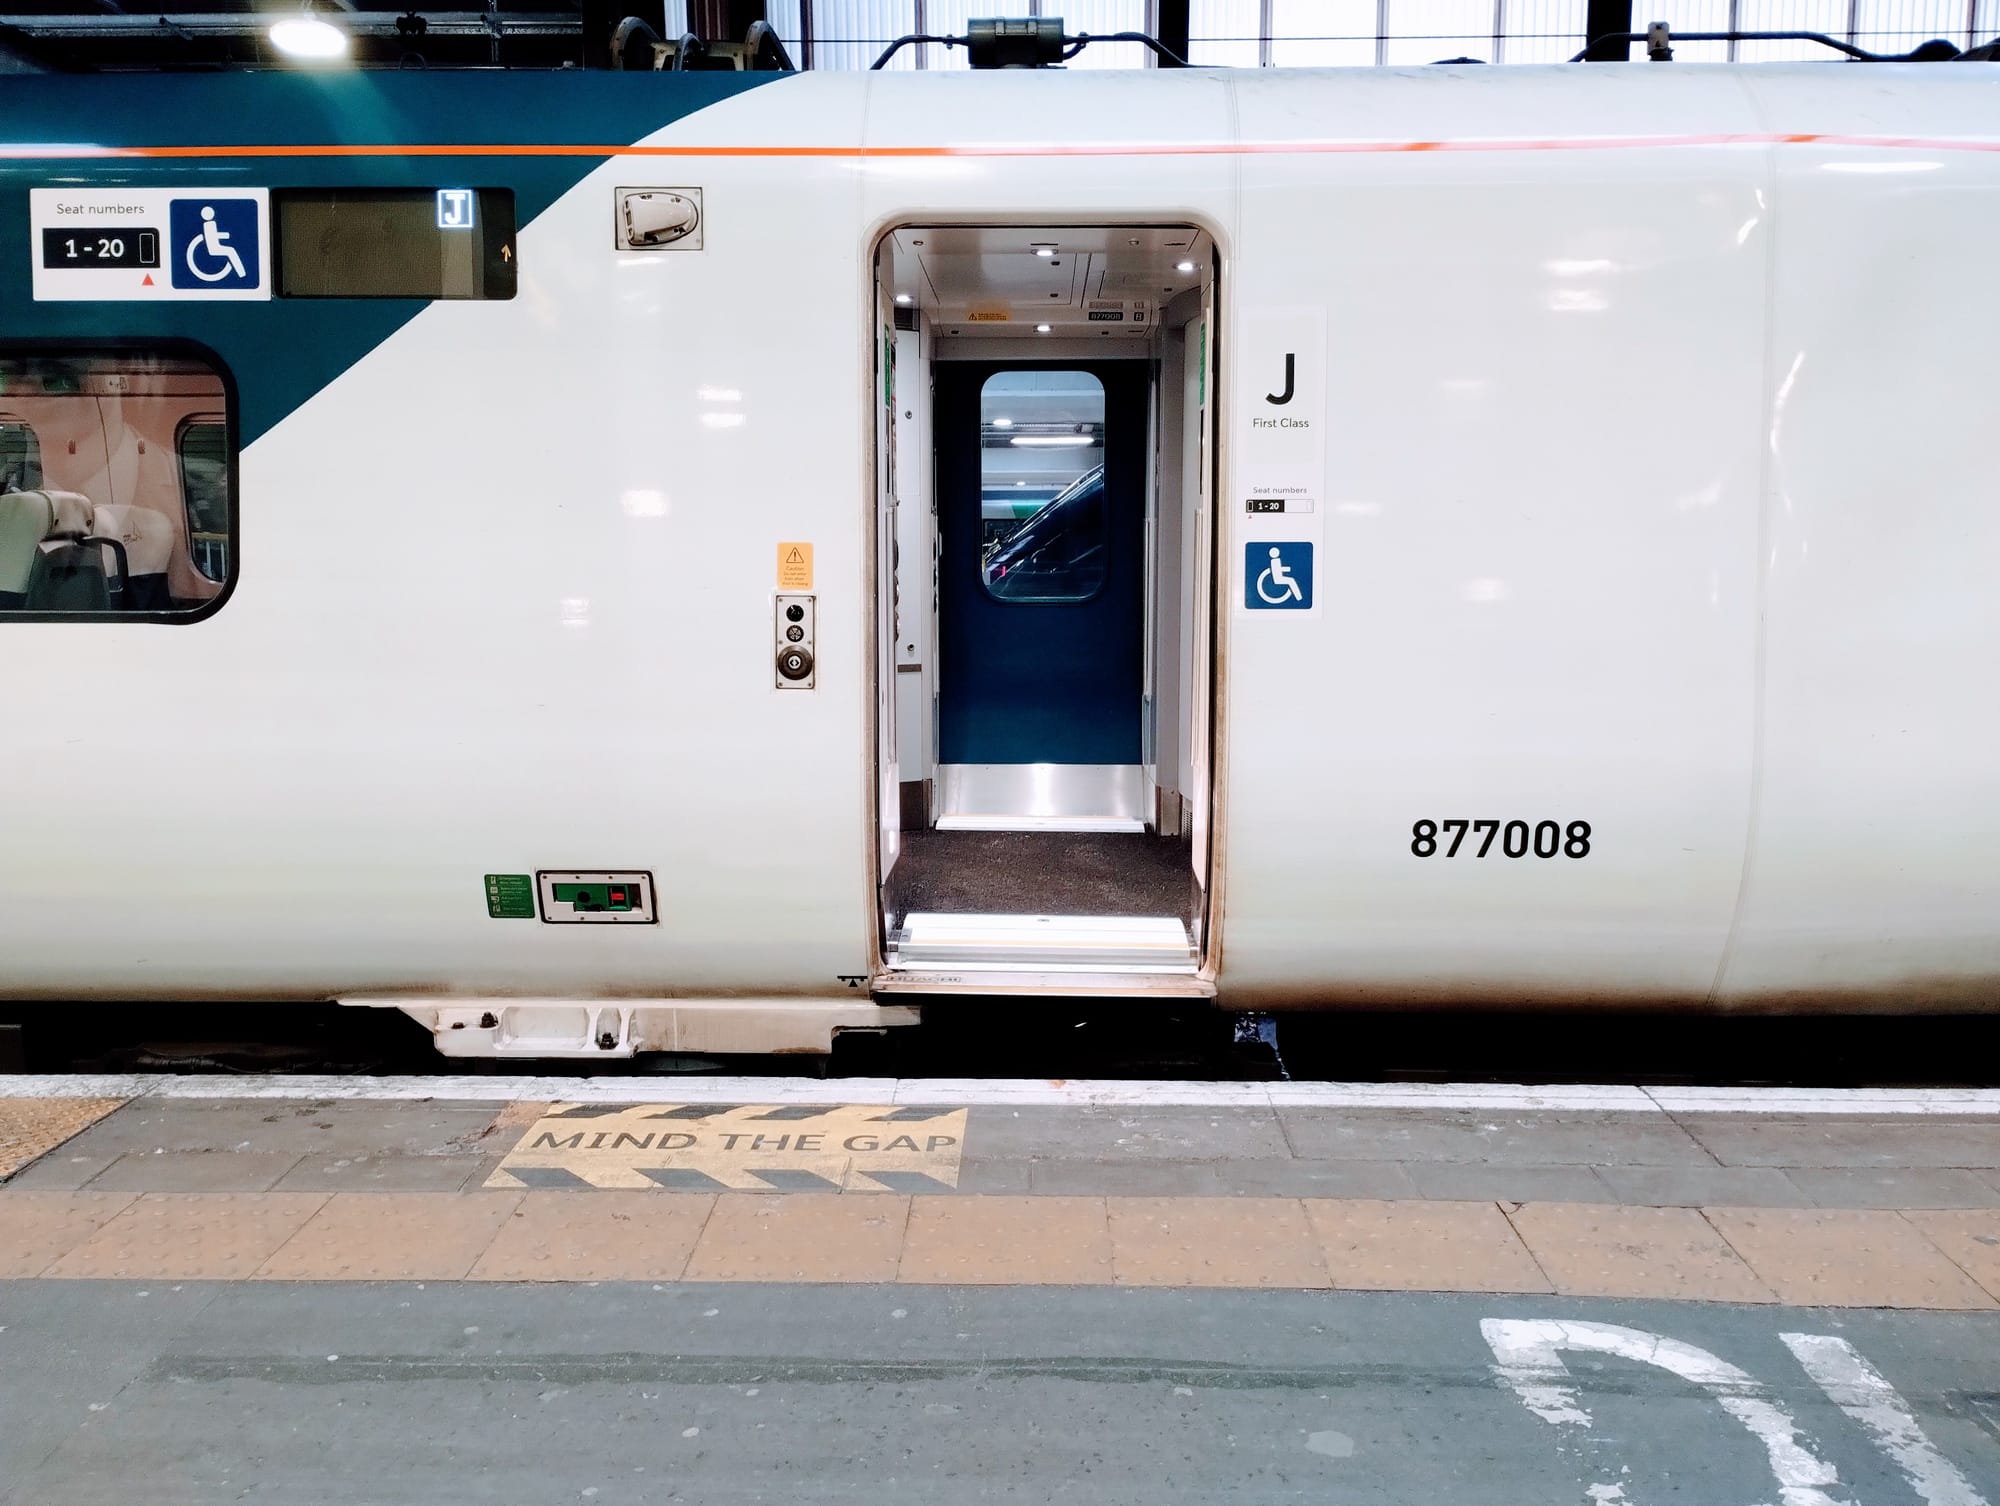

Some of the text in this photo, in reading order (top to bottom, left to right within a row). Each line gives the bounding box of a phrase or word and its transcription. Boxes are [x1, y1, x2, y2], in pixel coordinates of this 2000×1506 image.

[56, 203, 145, 214] Seat numbers
[445, 193, 465, 225] J
[98, 239, 125, 258] 20
[1265, 353, 1295, 405] J
[1253, 418, 1310, 428] First Class
[1253, 486, 1307, 494] Seat numbers
[1411, 819, 1592, 859] 877008
[530, 1131, 957, 1152] MIND THE GAP
